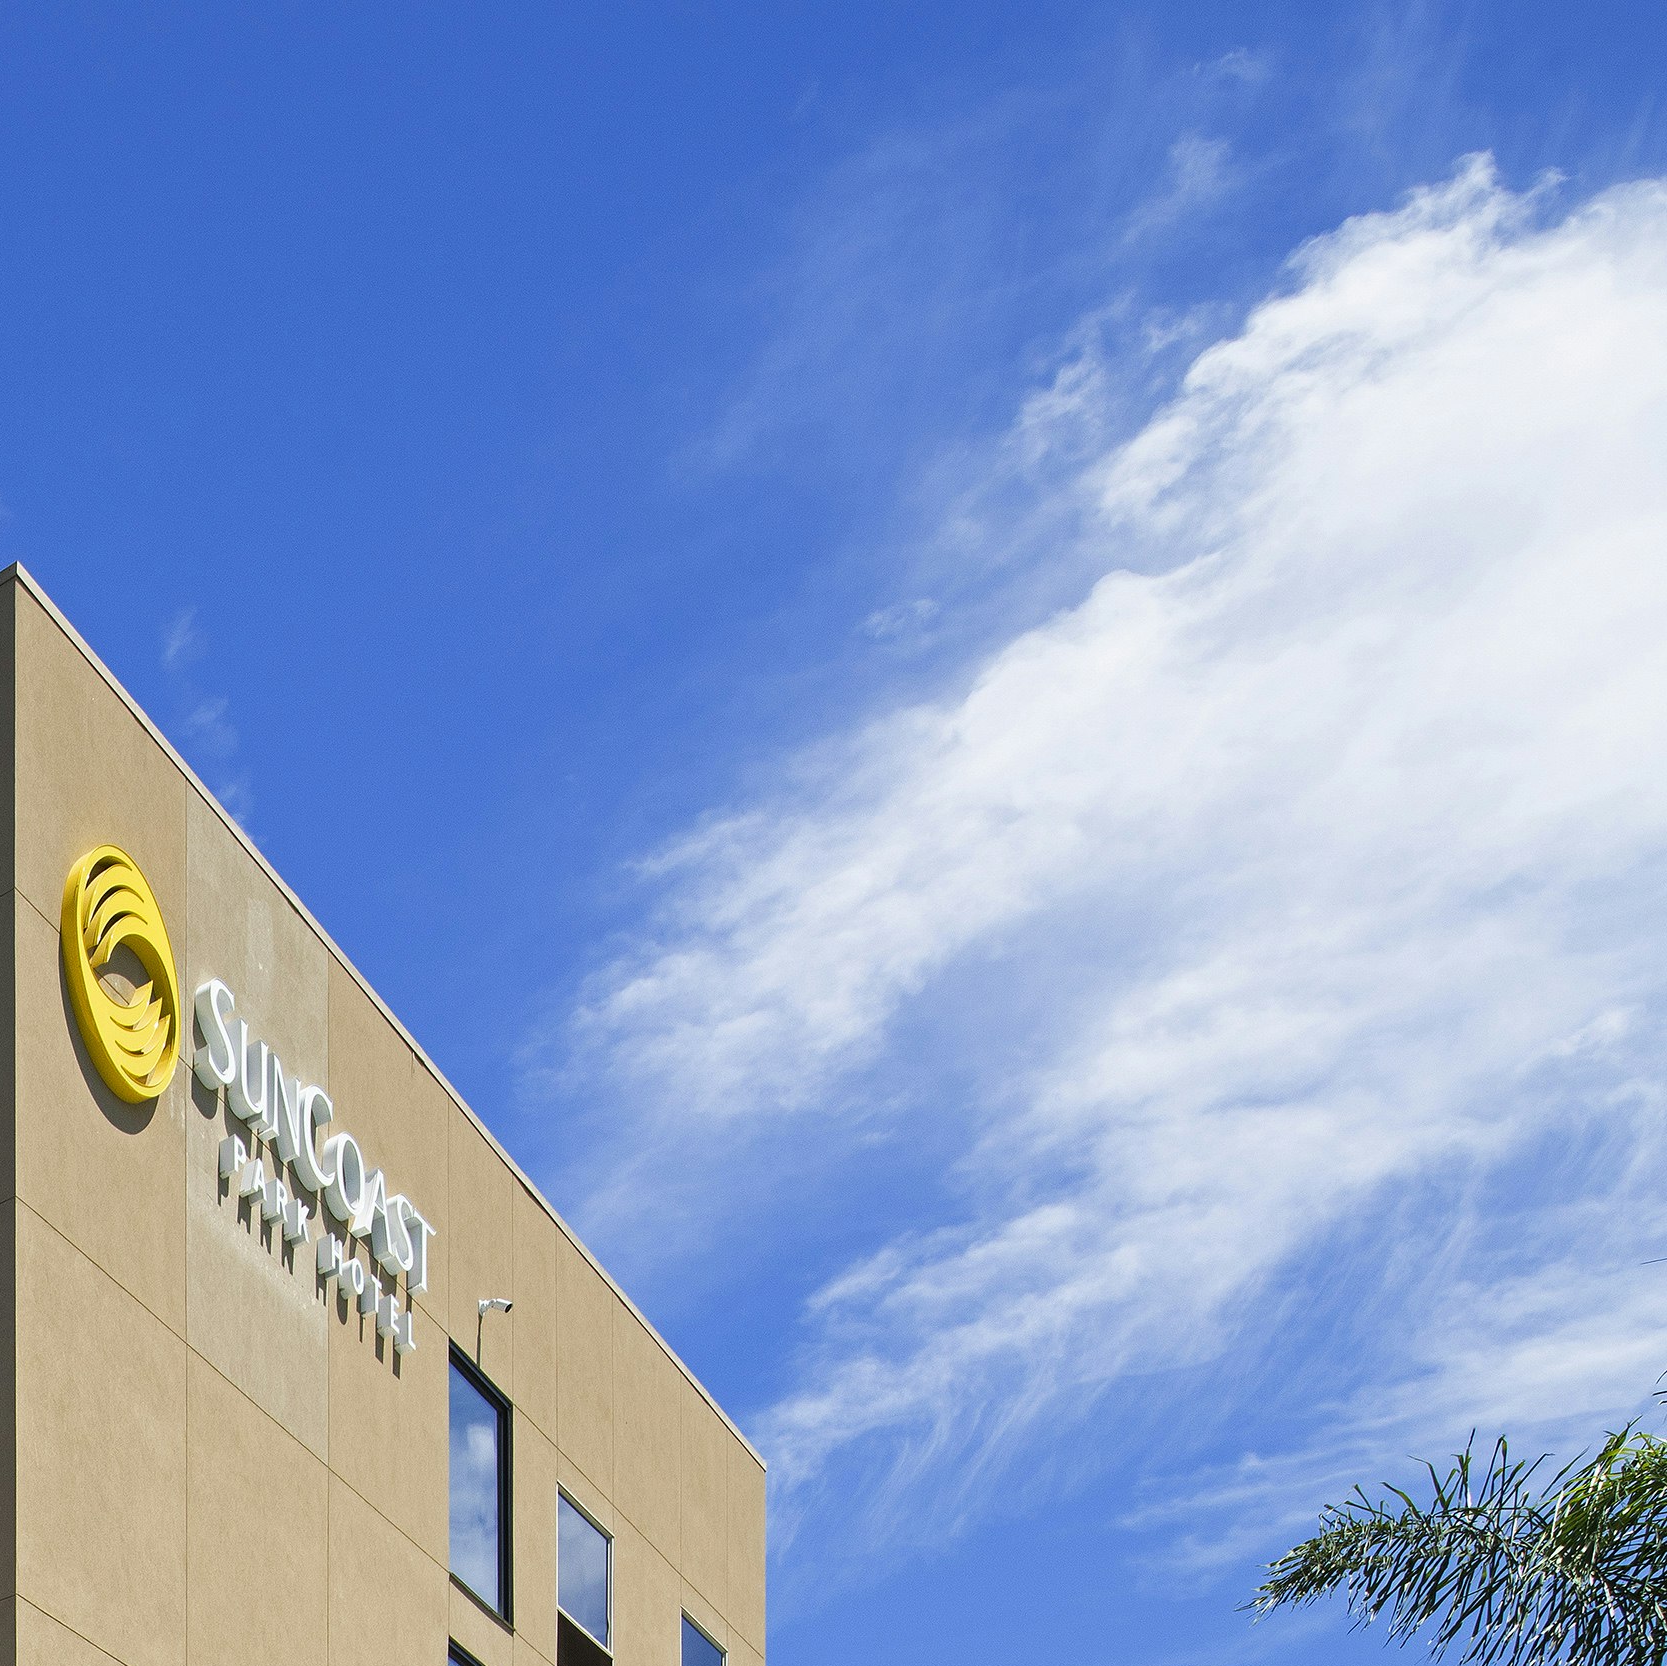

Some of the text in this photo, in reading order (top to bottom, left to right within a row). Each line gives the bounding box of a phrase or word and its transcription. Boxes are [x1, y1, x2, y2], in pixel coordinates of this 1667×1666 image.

[194, 978, 436, 1296] SUNCOAST
[219, 1133, 417, 1355] PARK HOTEL
